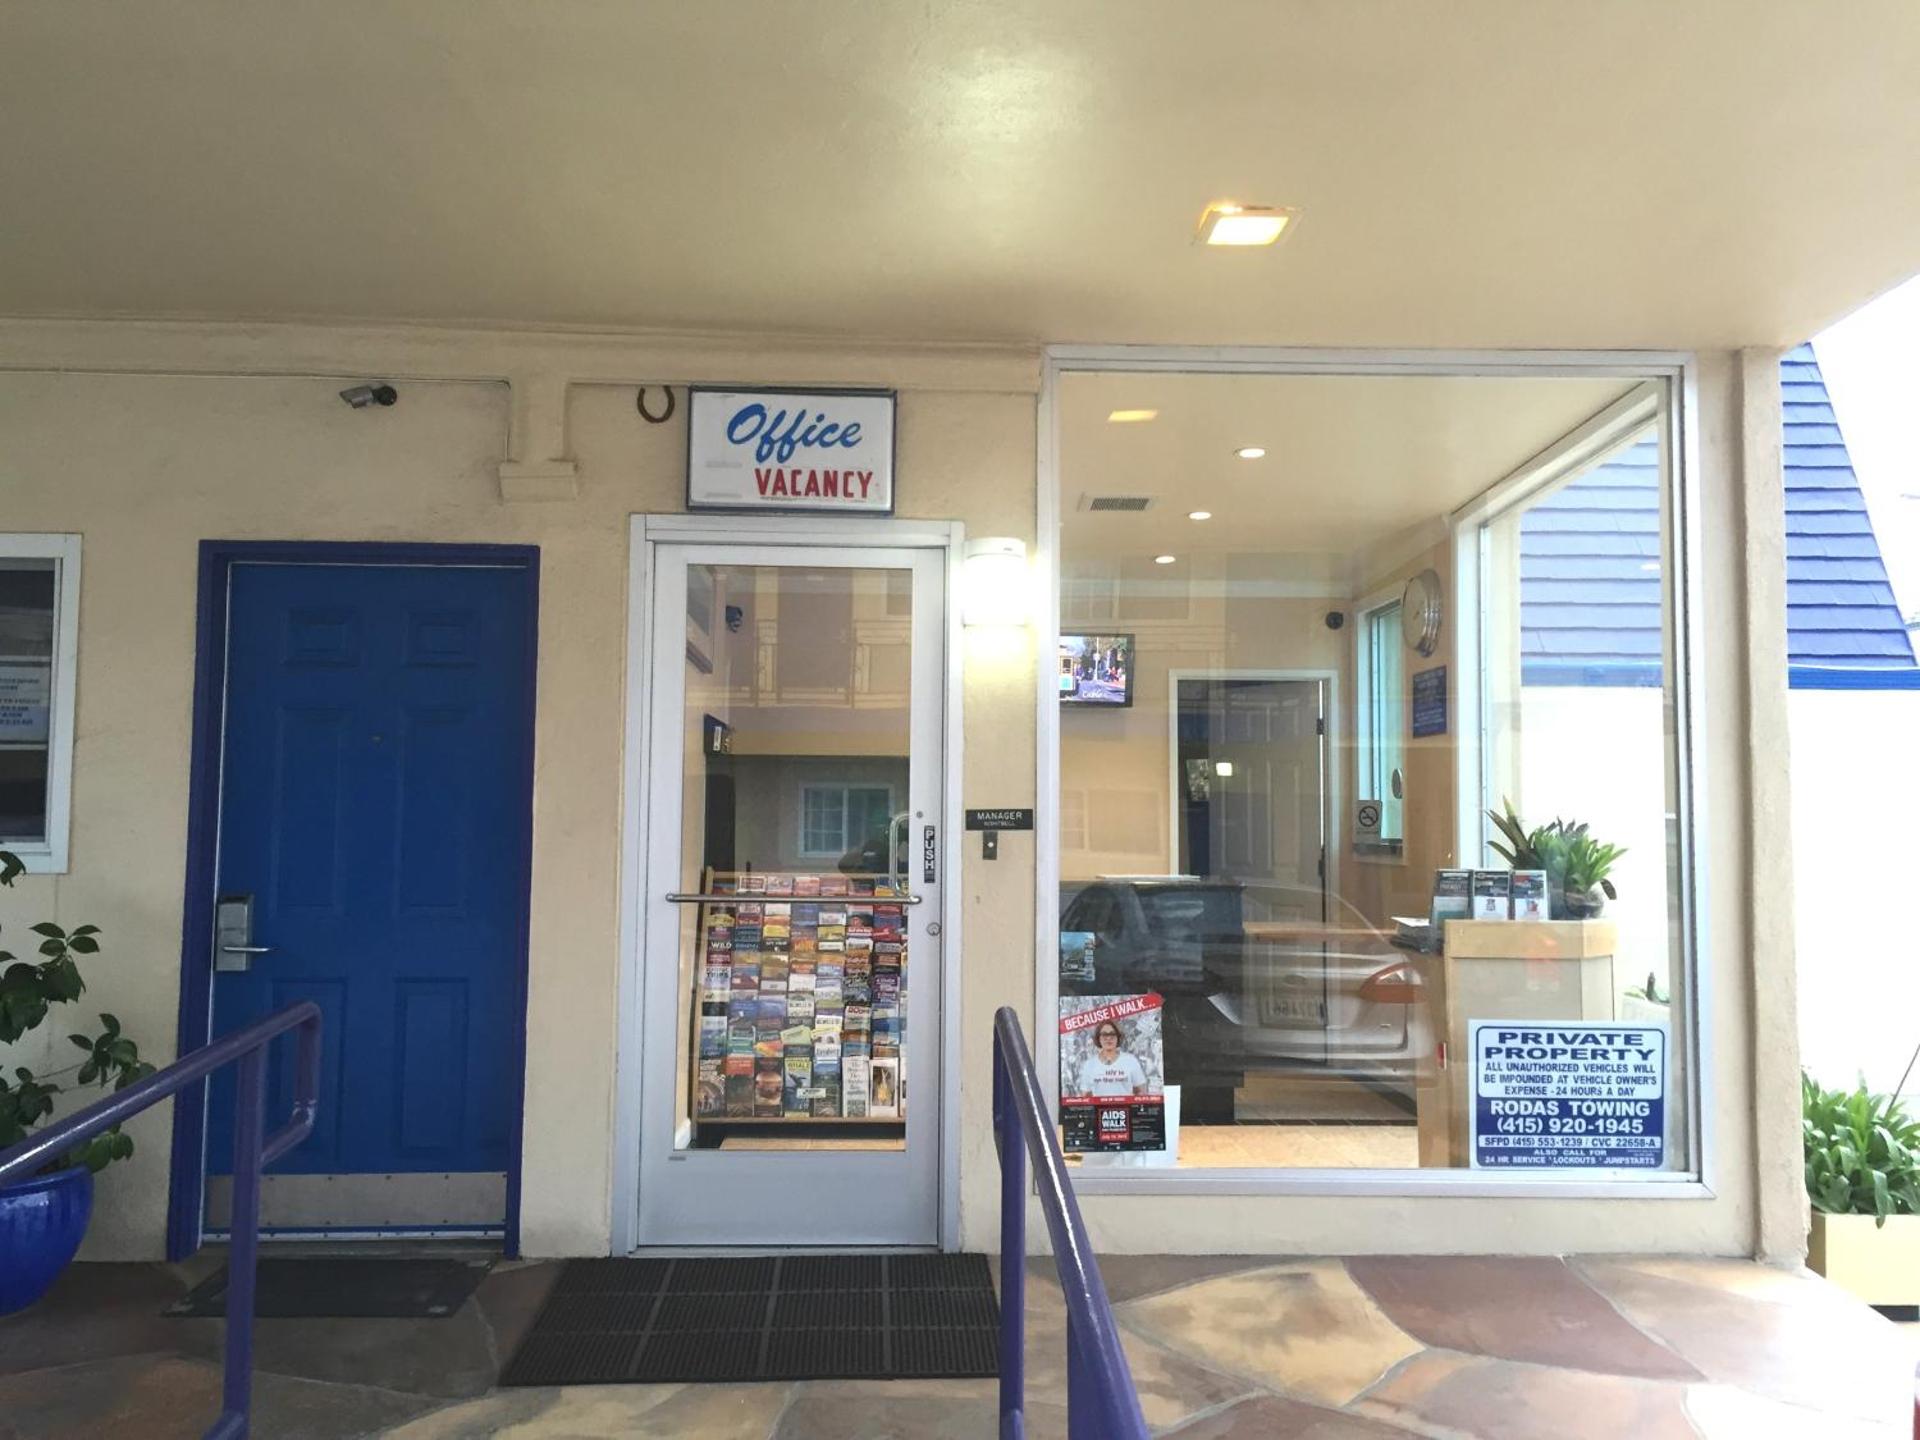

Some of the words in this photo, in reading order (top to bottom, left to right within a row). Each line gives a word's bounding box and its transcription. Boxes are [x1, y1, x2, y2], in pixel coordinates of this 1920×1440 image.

[727, 403, 863, 464] Office
[754, 467, 874, 499] VACANCY
[977, 811, 1023, 821] MANAGER
[925, 830, 934, 869] PUSH
[1064, 1008, 1110, 1031] BECAUSE
[1110, 1007, 1116, 1018] I
[1498, 1032, 1644, 1046] PRIVATE
[1485, 1046, 1655, 1061] PROPERTY
[1485, 1062, 1503, 1072] ALL
[1506, 1062, 1579, 1073] UNAUTHORIZED
[1583, 1063, 1629, 1073] VEHICLES
[1633, 1064, 1655, 1073] WILL
[1484, 1074, 1496, 1083] BE
[1499, 1074, 1553, 1084] IMPOUNDED
[1557, 1075, 1569, 1084] AT
[1573, 1075, 1612, 1085] VEHICLE
[1505, 1086, 1547, 1095] EXPENSE
[1555, 1086, 1568, 1095] 24
[1571, 1087, 1602, 1096] HOURS
[1606, 1087, 1613, 1096] A
[1617, 1087, 1636, 1096] DAY
[1490, 1100, 1560, 1116] RODAS
[1569, 1101, 1650, 1117] TOWING
[1101, 1110, 1126, 1120] AIDS
[1102, 1119, 1126, 1128] WALK
[1497, 1117, 1543, 1133] (415)
[1548, 1118, 1644, 1134] 920-1945
[1484, 1137, 1510, 1146] SFPD
[1513, 1137, 1535, 1146] (415)
[1537, 1138, 1583, 1146] 553-1239
[1591, 1138, 1611, 1147] CVC
[1512, 1156, 1546, 1164] SERVICE
